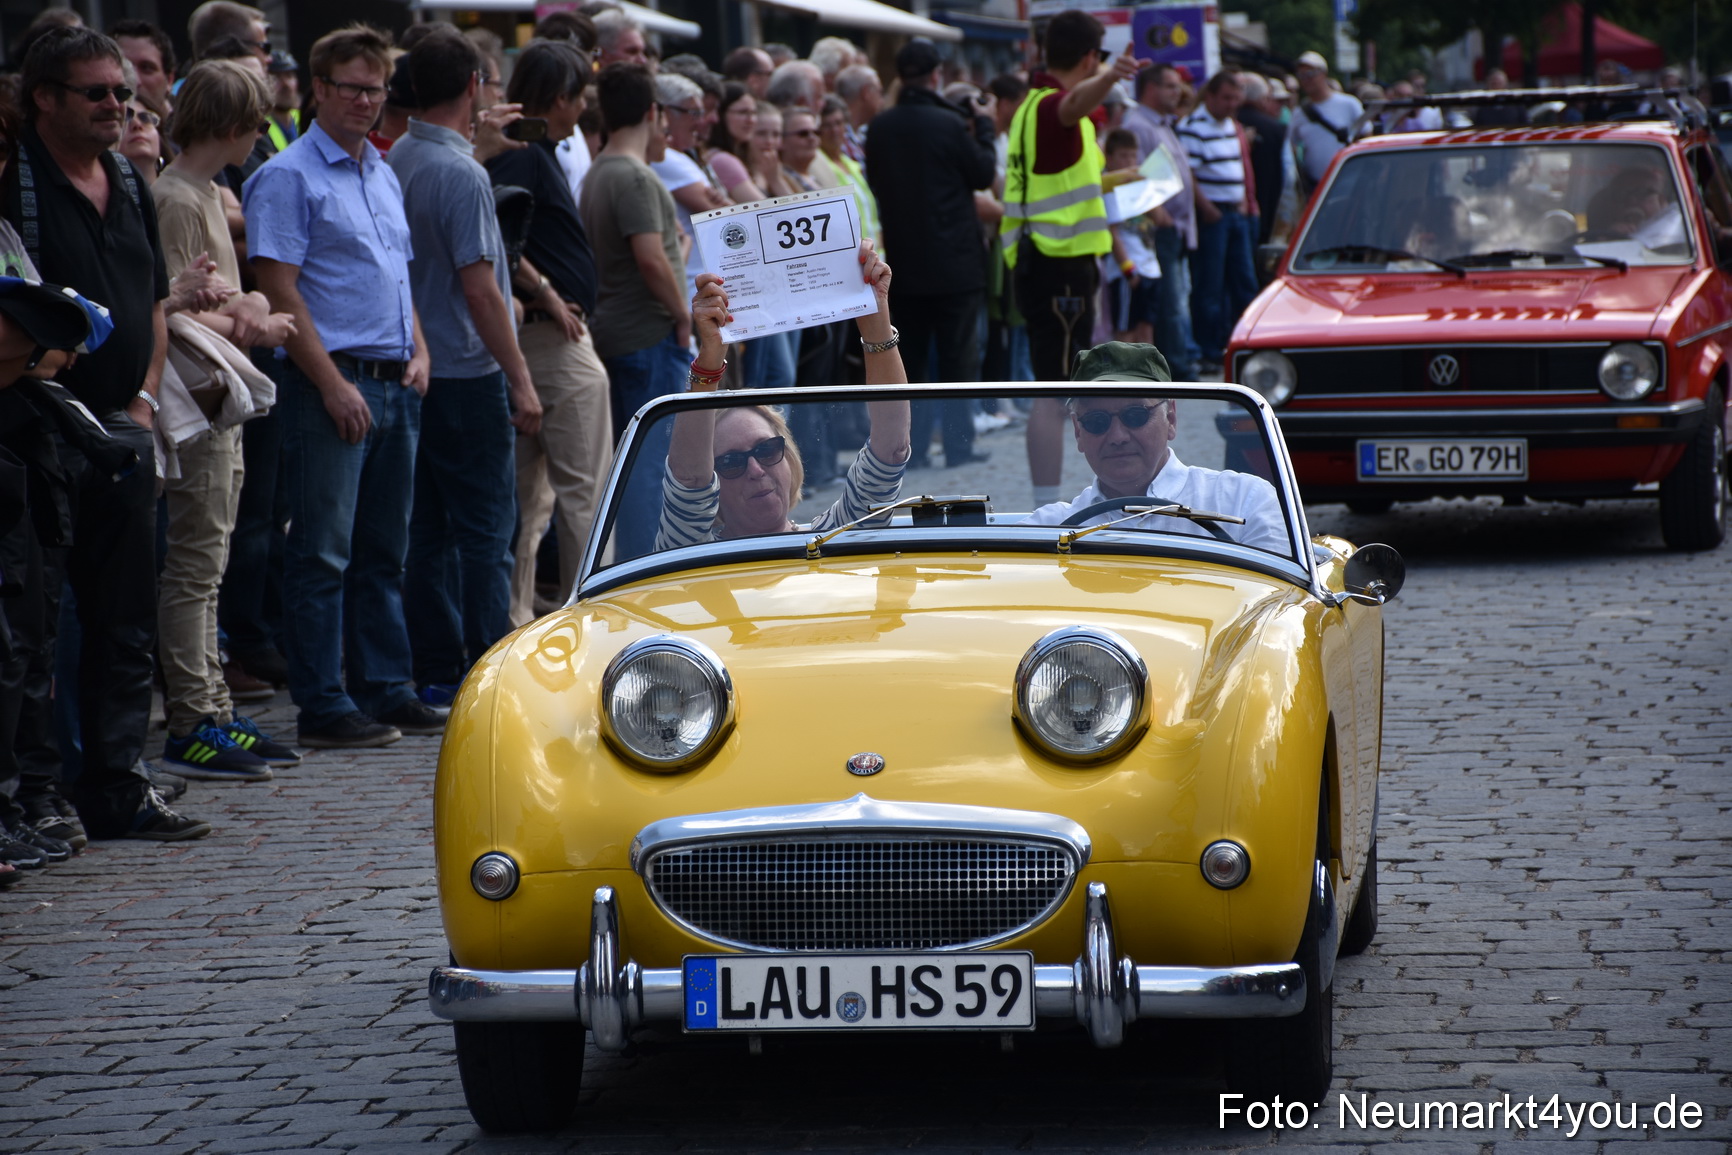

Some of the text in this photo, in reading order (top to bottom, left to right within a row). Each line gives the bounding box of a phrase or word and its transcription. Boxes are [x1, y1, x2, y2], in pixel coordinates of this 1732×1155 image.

[777, 213, 831, 249] 337
[786, 262, 807, 270] Fahrzeug
[1377, 445, 1522, 471] ER GO 79H
[721, 966, 830, 1020] LAU
[695, 1001, 707, 1016] D
